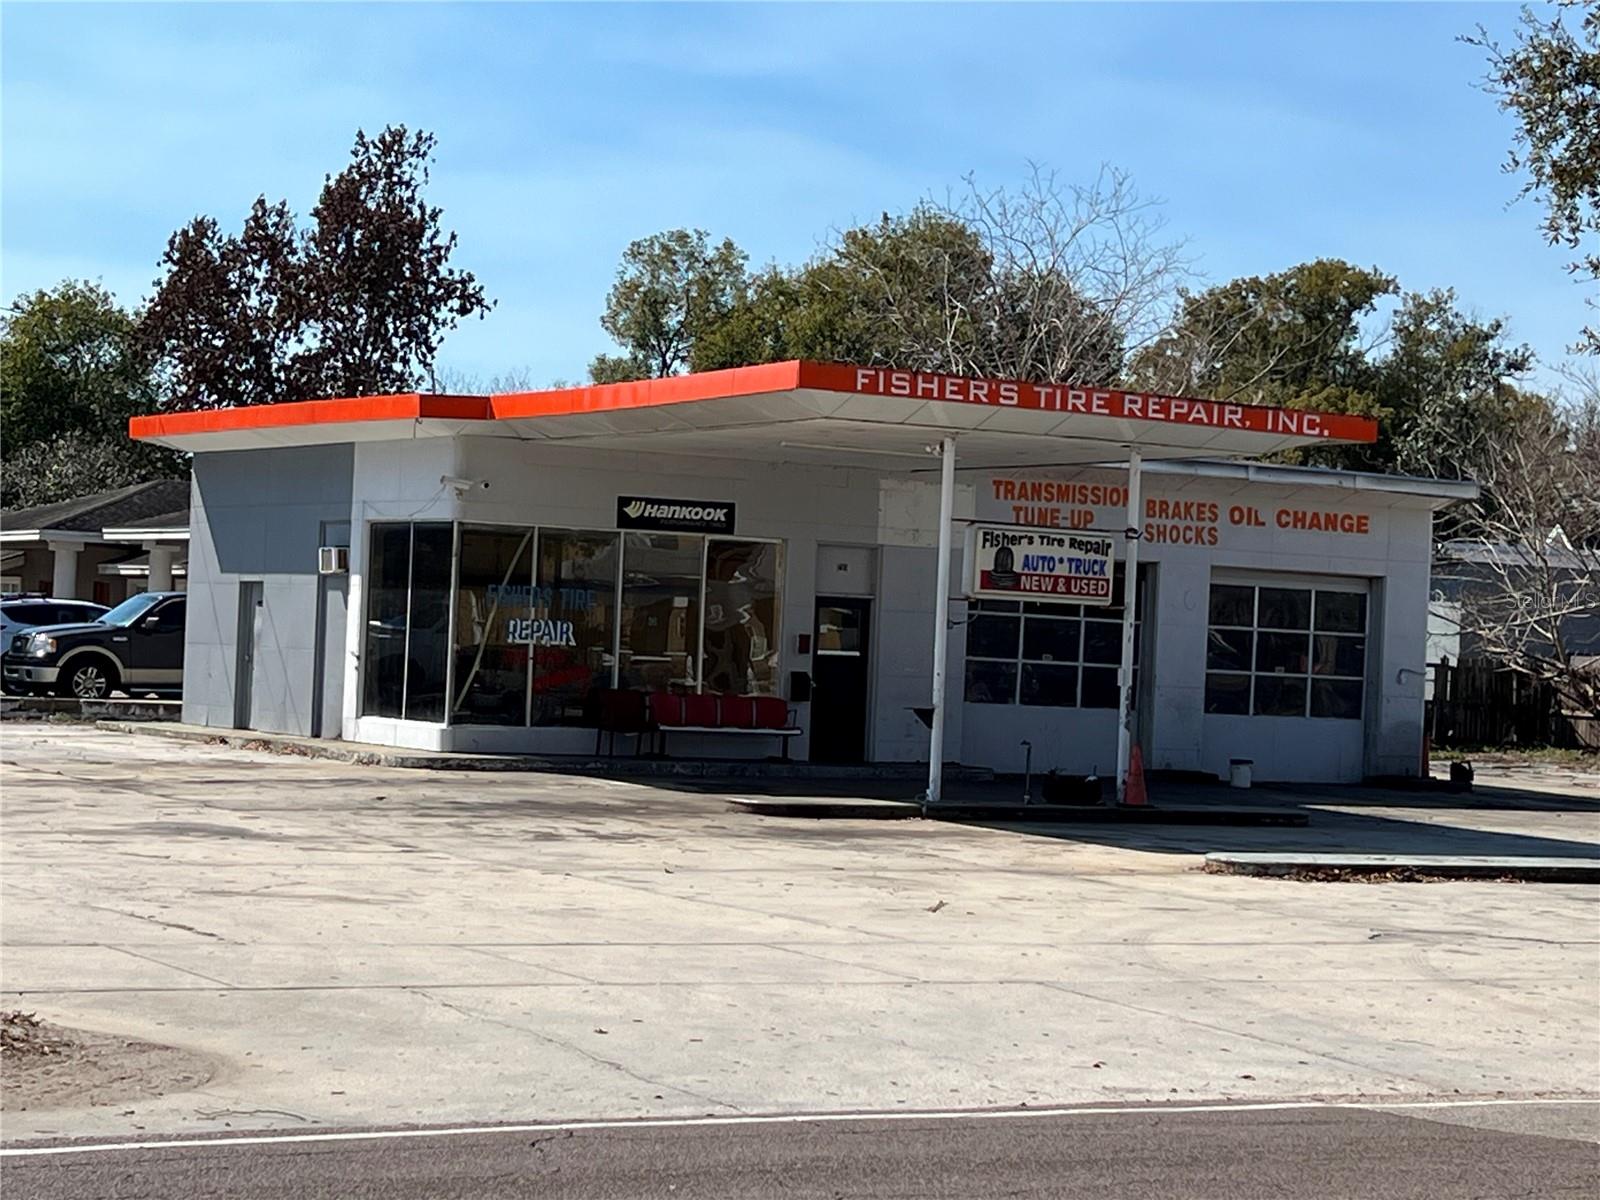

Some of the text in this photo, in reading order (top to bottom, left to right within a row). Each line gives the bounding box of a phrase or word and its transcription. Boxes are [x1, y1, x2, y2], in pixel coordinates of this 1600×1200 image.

[856, 368, 1330, 437] FISHER'S TIRE REPAIR, INC.
[1012, 505, 1094, 529] TUNE-UP
[1146, 499, 1218, 523] BRAKES
[1229, 505, 1369, 533] OIL CHANGE
[1144, 523, 1218, 546] SHOCKS
[1069, 537, 1112, 557] Repair
[1022, 554, 1107, 576] AUTO TRUCK
[1020, 575, 1108, 596] NEW & USED
[559, 588, 597, 609] TIRE
[506, 618, 577, 647] REPAIR
